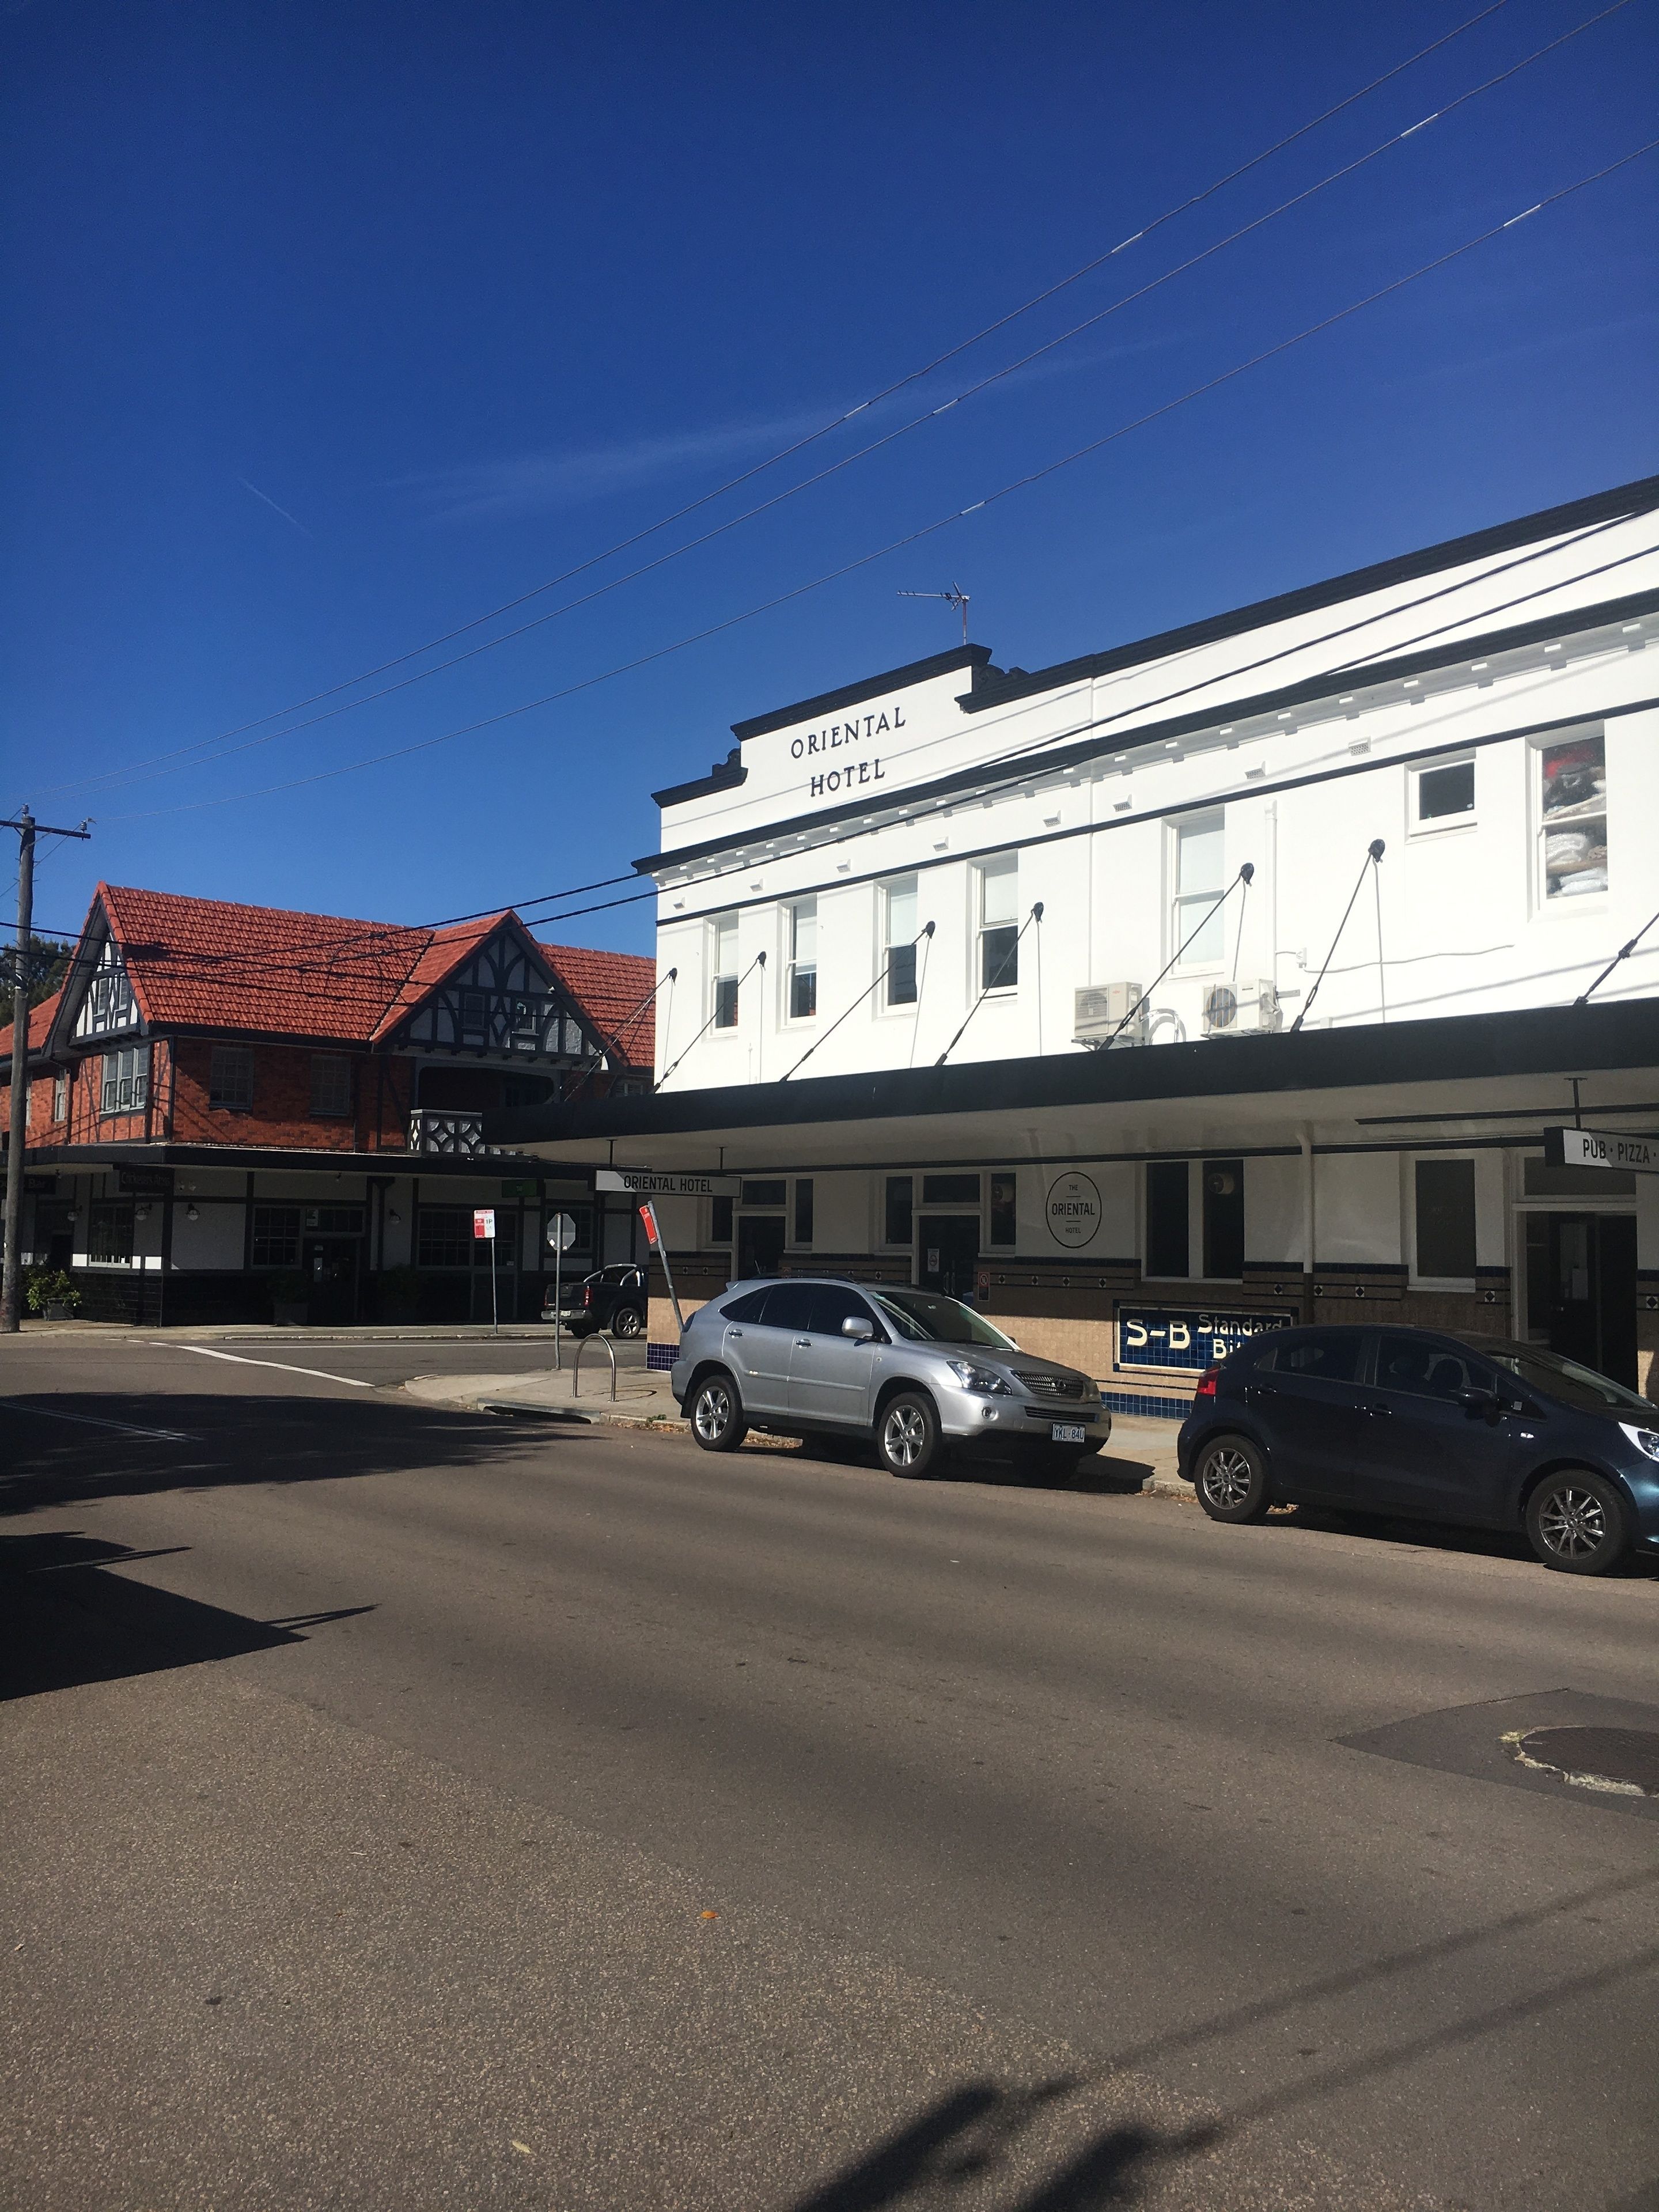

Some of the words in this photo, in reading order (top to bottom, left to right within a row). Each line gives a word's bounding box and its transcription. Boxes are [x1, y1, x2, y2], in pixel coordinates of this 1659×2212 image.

[791, 707, 906, 759] ORIENTAL
[810, 759, 885, 797] HOTEL
[1582, 1139, 1606, 1159] PUB
[1618, 1143, 1650, 1164] PIZZA
[624, 1175, 676, 1190] ORIENTAL
[680, 1179, 713, 1192] HOTEL
[1052, 1203, 1095, 1215] ORIENTAL
